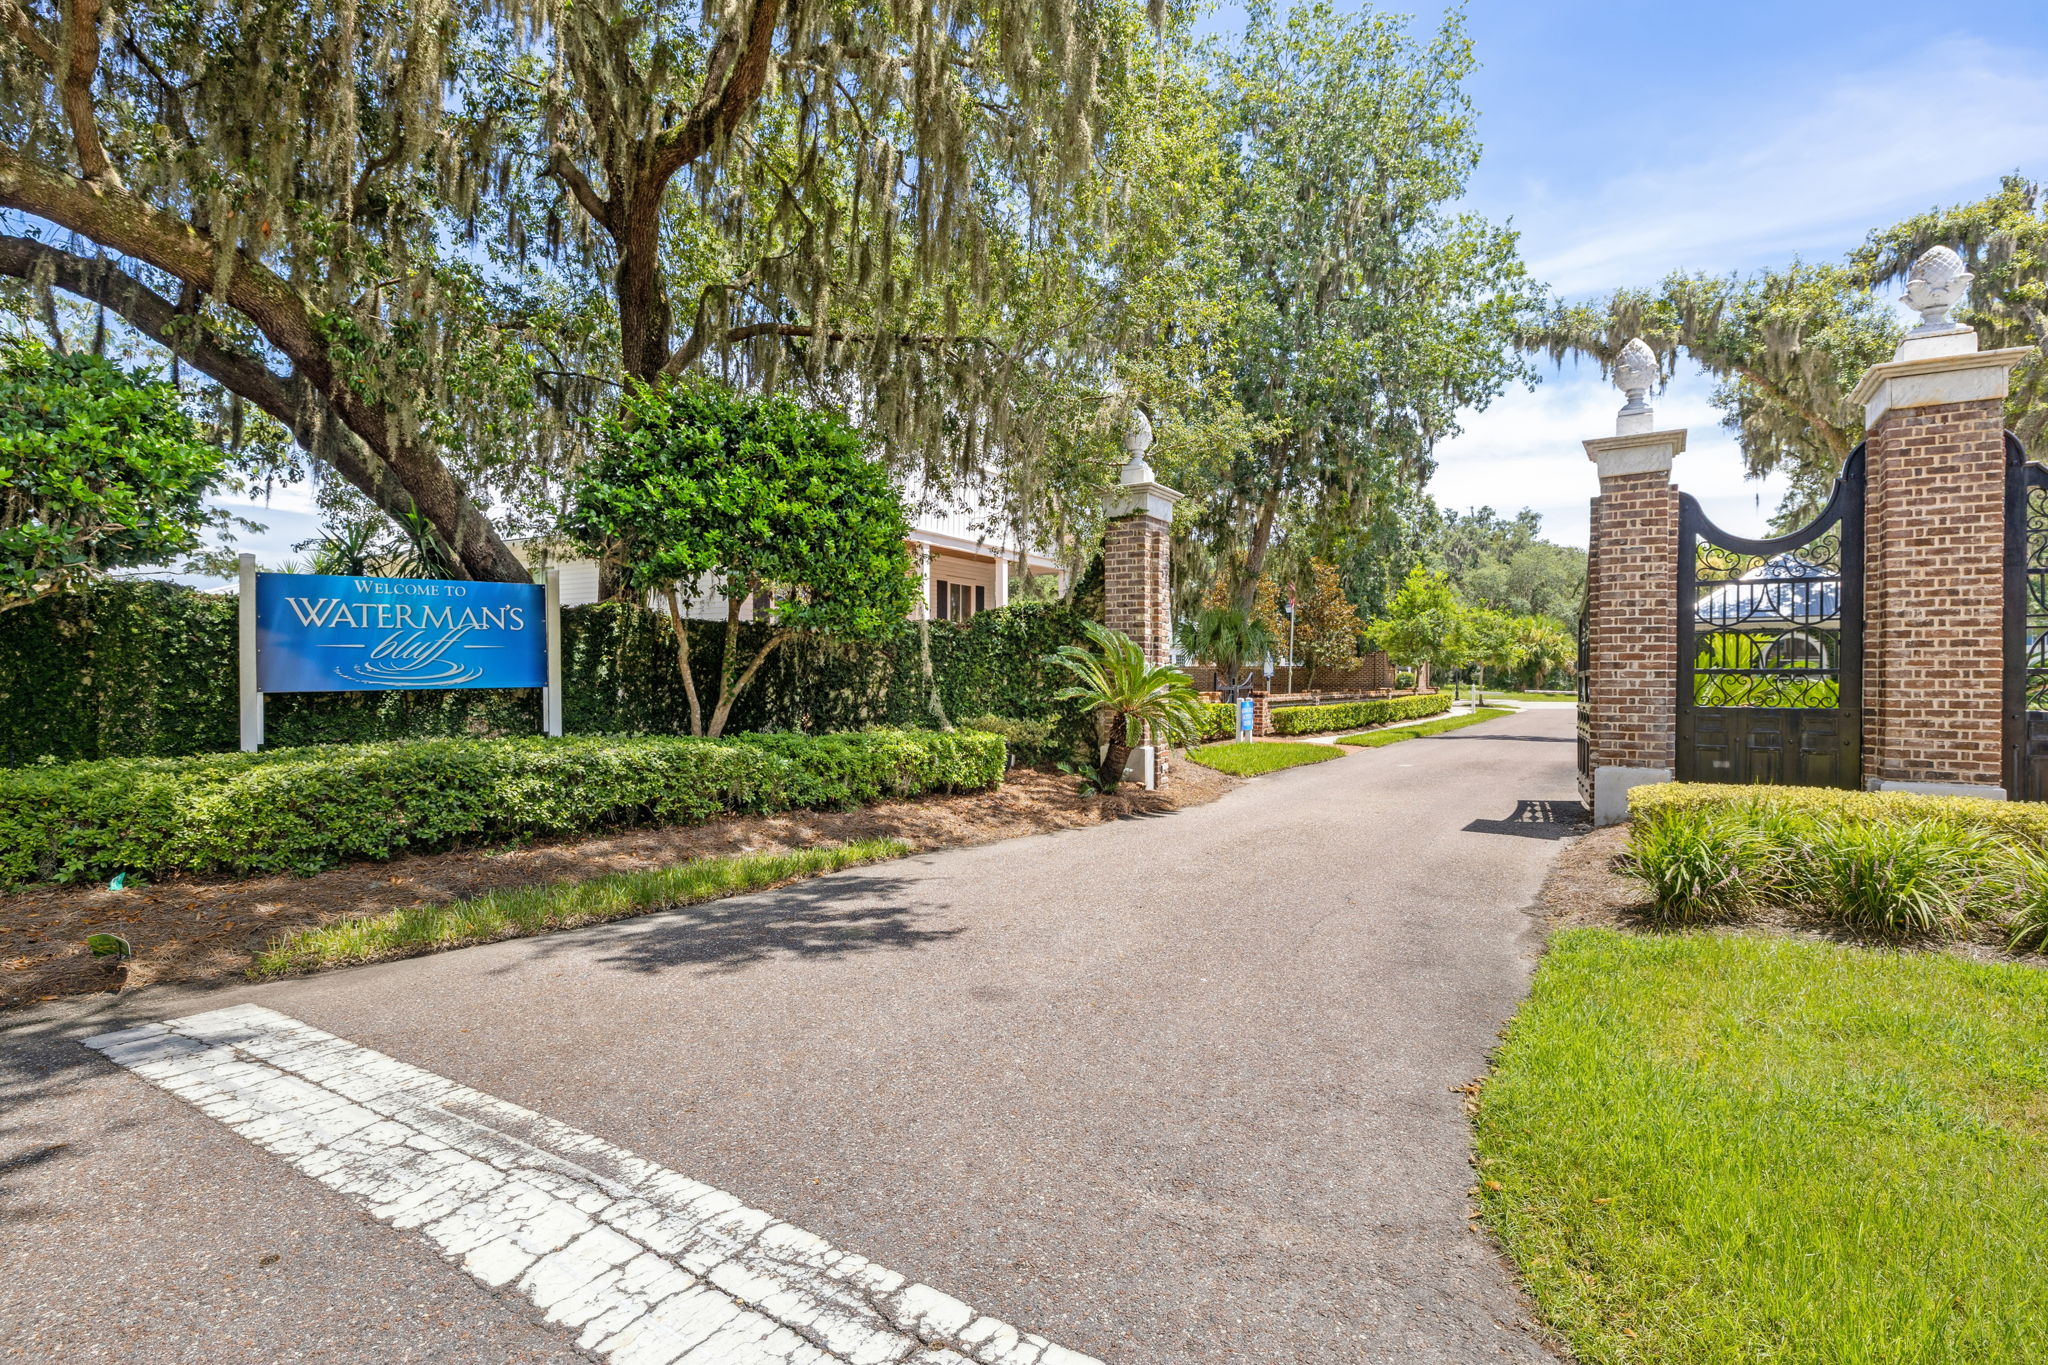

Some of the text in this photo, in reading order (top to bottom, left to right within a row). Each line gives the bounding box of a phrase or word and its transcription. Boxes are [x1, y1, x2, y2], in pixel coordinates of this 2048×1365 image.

[353, 579, 467, 597] WELCOME TO
[284, 597, 525, 631] WATERMAN'S
[370, 624, 488, 670] bluff
